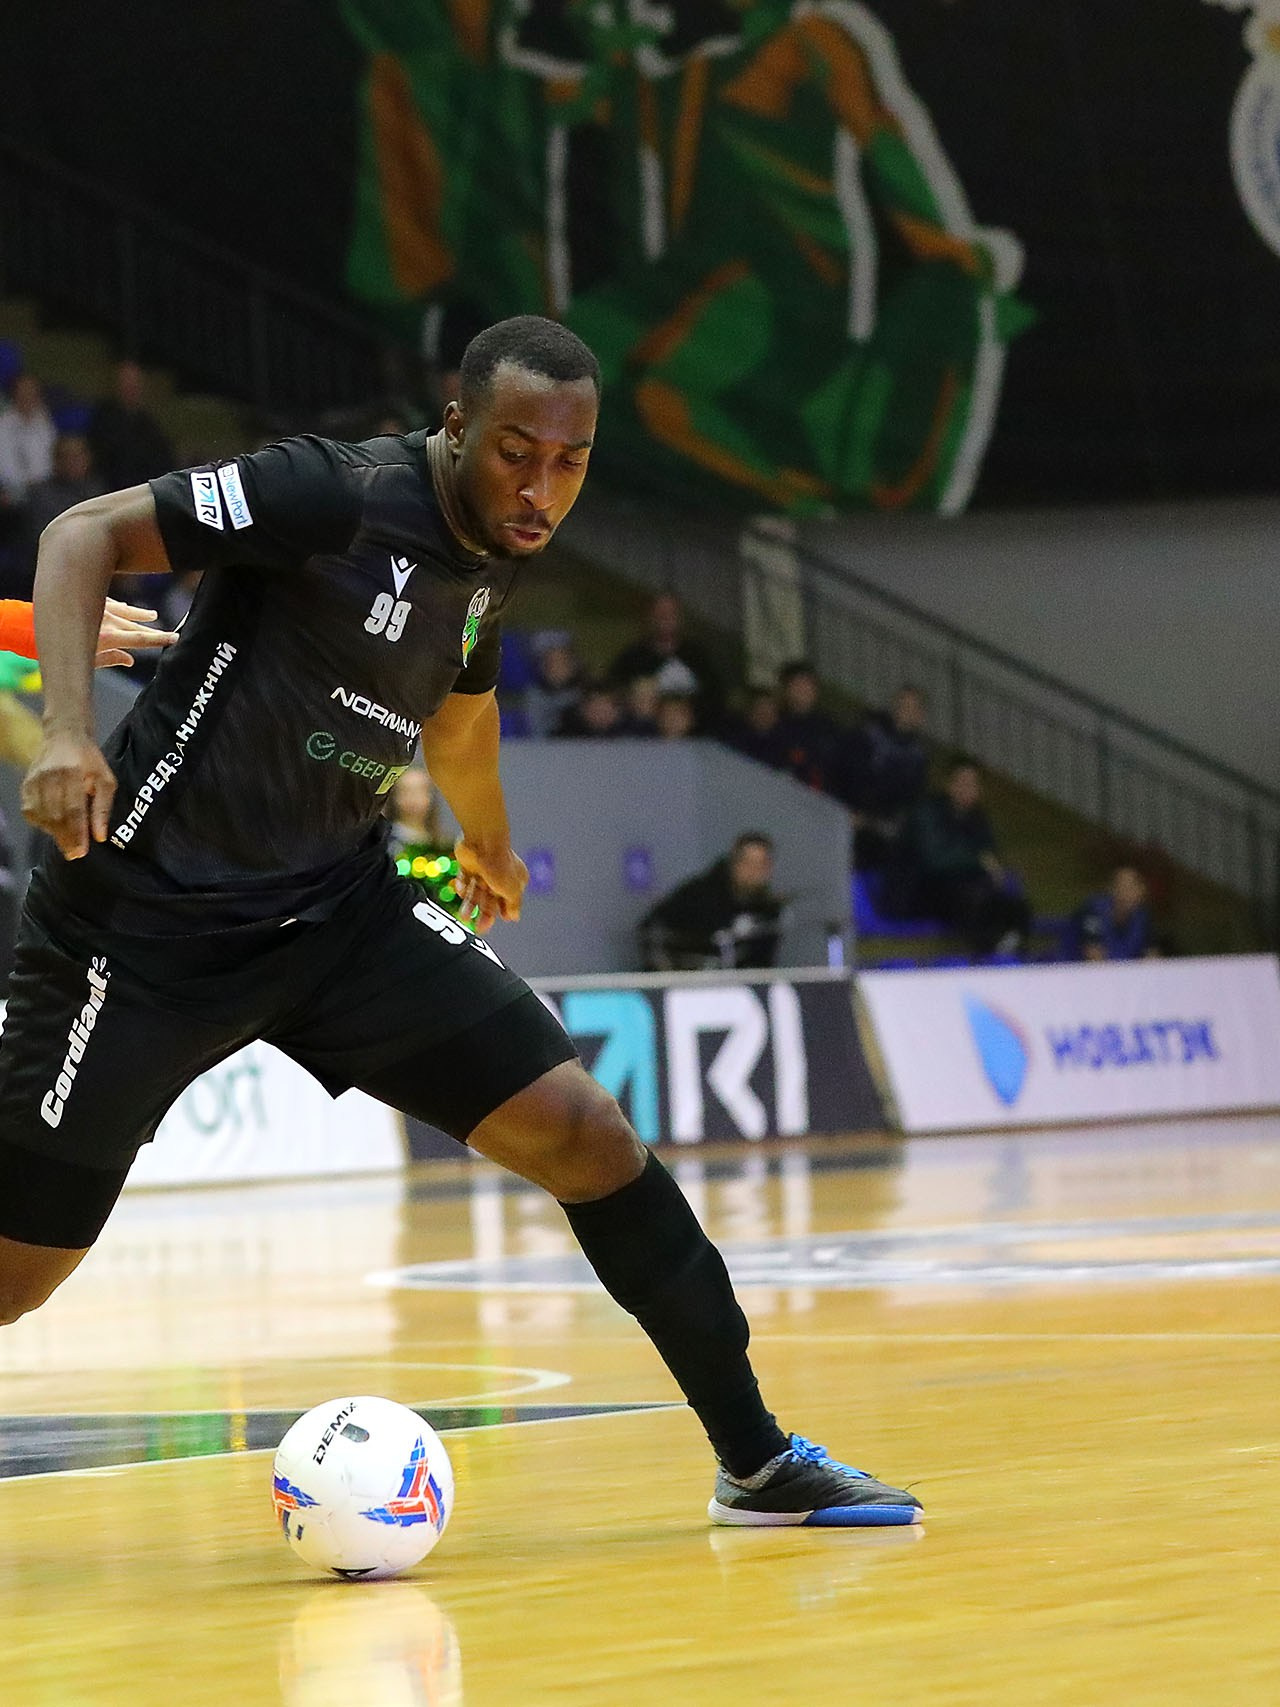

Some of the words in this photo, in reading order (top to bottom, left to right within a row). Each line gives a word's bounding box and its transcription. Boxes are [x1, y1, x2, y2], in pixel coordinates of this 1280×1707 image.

[196, 477, 218, 525] PARI
[364, 593, 412, 642] 99
[330, 687, 422, 739] NORMAN
[339, 751, 385, 780] СБЕР
[40, 967, 108, 1129] Cordiant
[538, 982, 810, 1144] ARI
[312, 1401, 358, 1465] DEMIX
